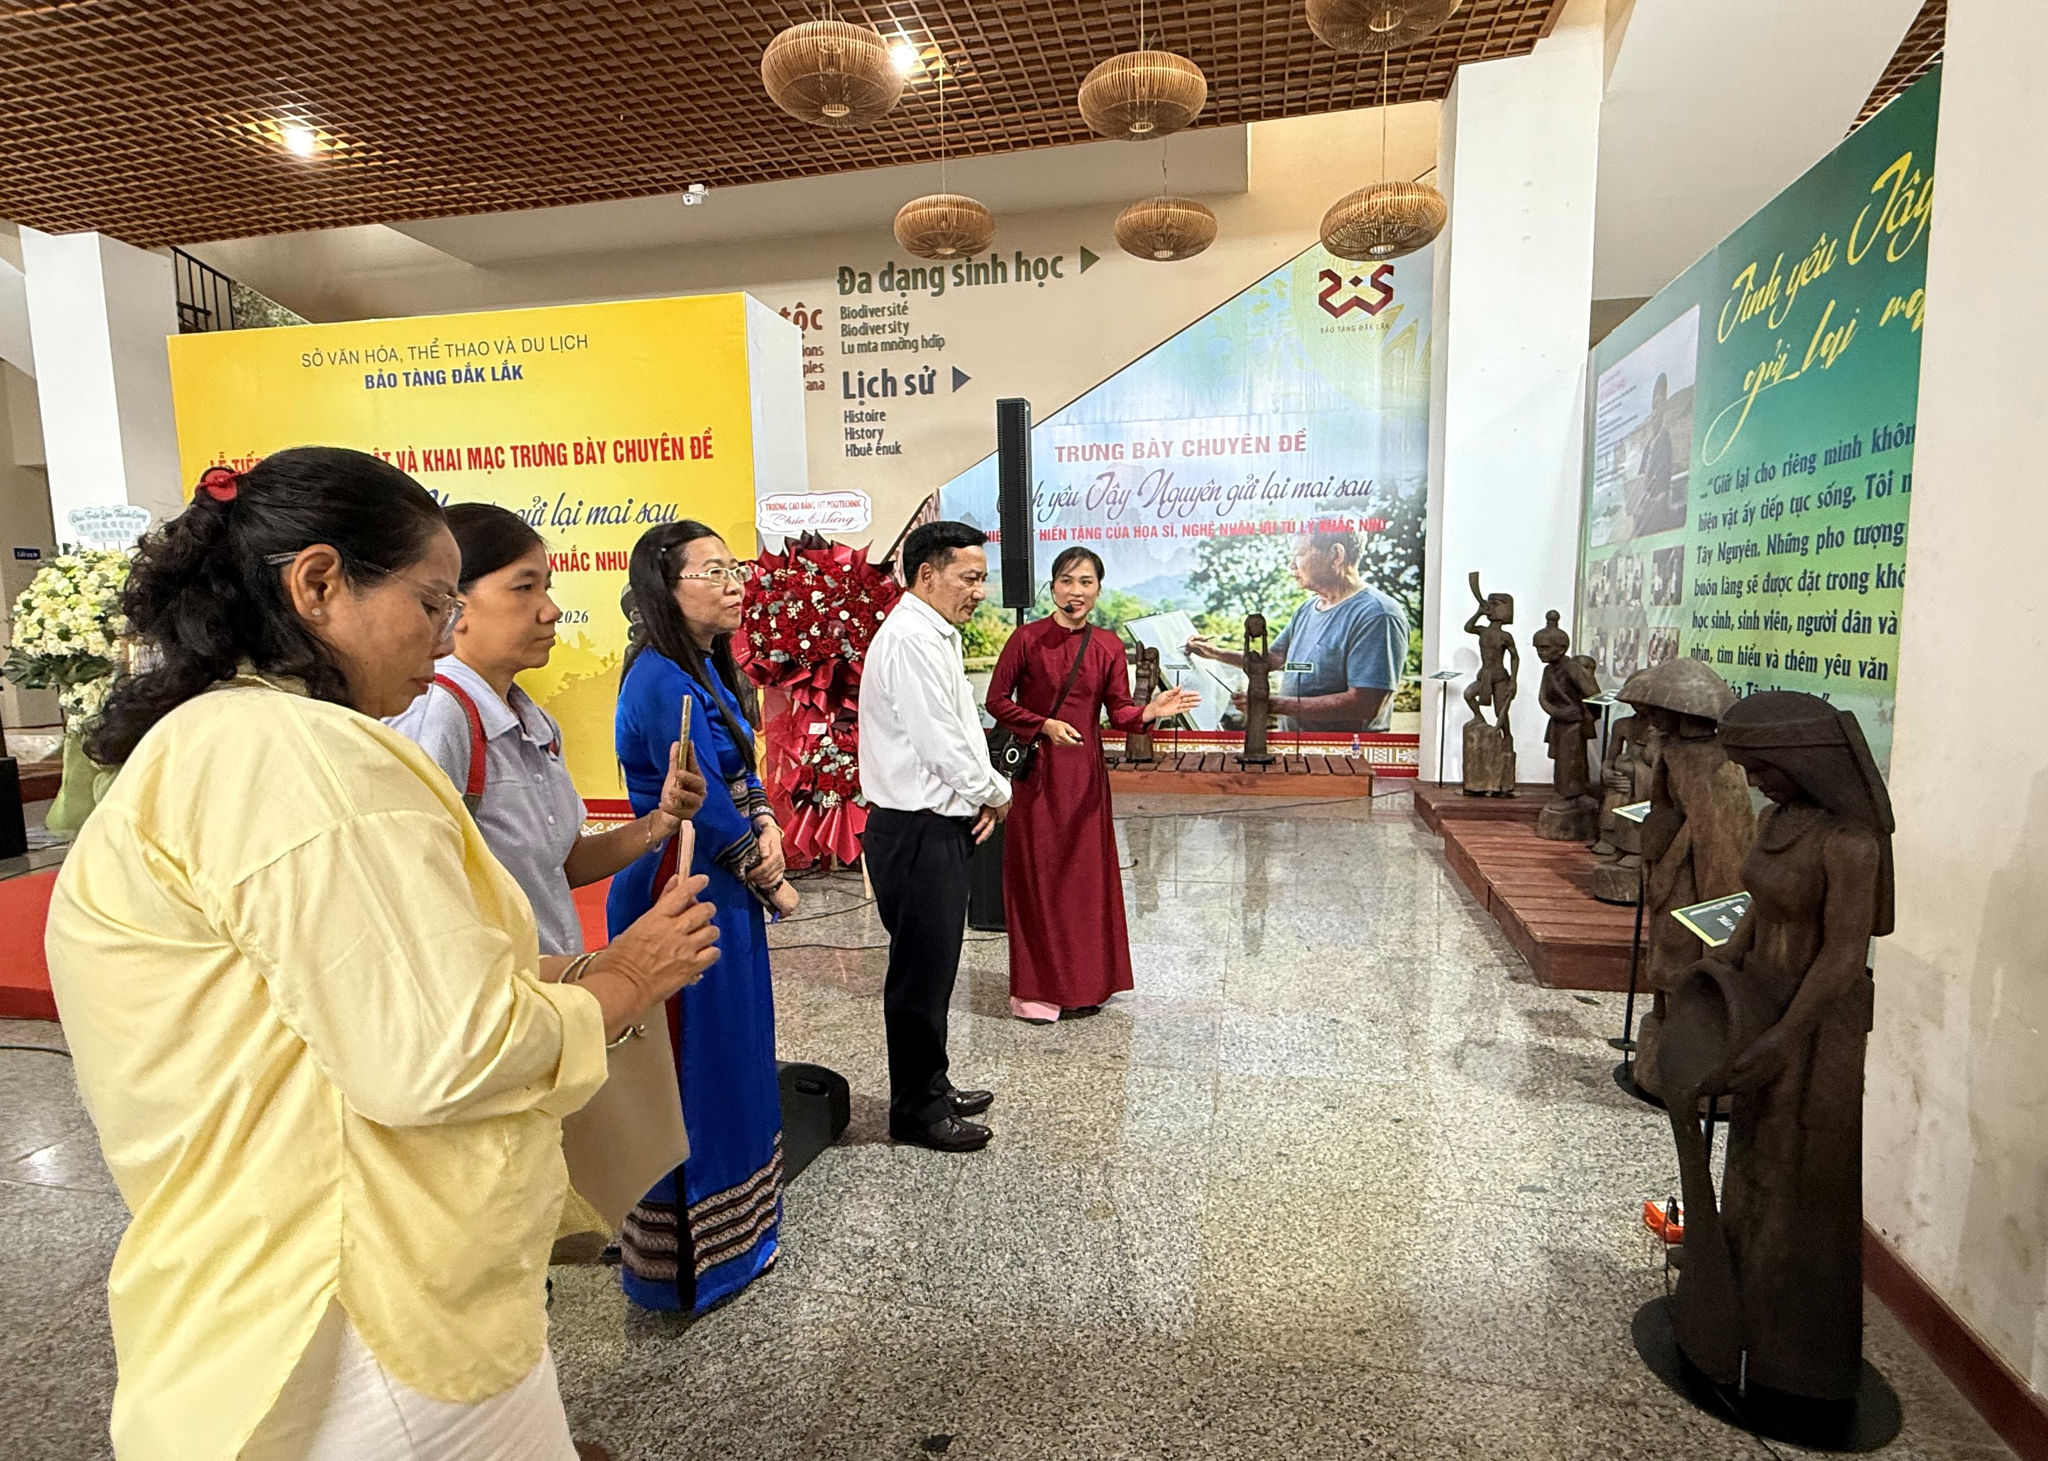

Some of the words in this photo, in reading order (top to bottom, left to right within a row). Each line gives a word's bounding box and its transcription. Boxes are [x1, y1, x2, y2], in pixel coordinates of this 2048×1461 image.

[1768, 232, 1838, 330] yêu
[1847, 151, 1934, 266] Tây
[837, 266, 872, 295] Đa
[878, 261, 944, 298] dạng
[952, 253, 1008, 287] sinh
[1015, 251, 1064, 288] học
[840, 301, 909, 320] Biodiversité
[841, 321, 909, 337] Biodiversity
[302, 348, 324, 368] SỞ
[328, 349, 360, 367] VĂN
[365, 344, 403, 364] HÓA,
[407, 338, 440, 360] THỂ
[445, 341, 490, 358] THAO
[494, 336, 519, 354] VÀ
[522, 337, 545, 353] DU
[550, 334, 588, 353] LỊCH
[1801, 299, 1861, 372] lại
[364, 368, 398, 390] BẢO
[402, 367, 447, 387] TÀNG
[451, 362, 486, 384] ĐẮK
[491, 359, 523, 382] LẮK
[842, 368, 898, 406] Lịch
[904, 365, 936, 395] sử
[844, 409, 886, 423] Histoire
[396, 445, 418, 473] VÀ
[422, 448, 462, 472] KHAI
[467, 446, 506, 475] MẠC
[510, 441, 568, 468] TRƯNG
[573, 436, 606, 465] BÀY
[613, 432, 684, 463] CHUYÊN
[690, 427, 714, 460] ĐỀ
[845, 427, 884, 444] History
[1054, 442, 1125, 463] TRƯNG
[1132, 437, 1174, 459] BÀY
[1181, 433, 1270, 458] CHUYÊN
[1278, 427, 1307, 452] ĐỀ
[1736, 466, 1750, 493] lại
[1754, 461, 1776, 484] cho
[1782, 452, 1817, 477] riêng
[1871, 422, 1916, 454] khôn
[551, 492, 582, 534] lại
[585, 498, 631, 526] mai
[633, 503, 679, 524] sau
[1038, 483, 1079, 523] yêu
[1085, 471, 1131, 520] Tây
[1137, 468, 1221, 519] Nguyên
[1215, 473, 1260, 517] gửi
[1260, 470, 1291, 506] lại
[1291, 475, 1335, 499] mai
[1335, 479, 1373, 498] sau
[1760, 494, 1784, 521] tiếp
[1790, 494, 1811, 518] tục
[1864, 469, 1894, 500] Tôi
[1039, 524, 1067, 541] HIẾN
[1070, 524, 1102, 543] TẶNG
[1105, 522, 1130, 540] CỦA
[1182, 519, 1215, 538] NGHỆ
[1280, 517, 1296, 534] TÚ
[1300, 517, 1314, 533] LÝ
[1697, 545, 1713, 567] Tây
[1766, 532, 1809, 556] Những
[1815, 525, 1845, 555] pho
[1853, 522, 1906, 550] tượng
[548, 545, 590, 572] KHẮC
[595, 551, 628, 571] NHU
[1721, 576, 1744, 599] làng
[1746, 574, 1758, 594] sẽ
[1762, 571, 1793, 597] được
[1797, 569, 1821, 597] đặt
[1826, 571, 1870, 595] trong
[1875, 562, 1907, 589] khô
[1692, 610, 1709, 632] học
[1711, 609, 1735, 631] sinh,
[1737, 609, 1760, 630] sinh
[1763, 609, 1793, 634] viên,
[1796, 608, 1838, 637] người
[1841, 608, 1872, 634] dân
[1878, 610, 1898, 635] và
[1717, 644, 1734, 664] tìm
[1737, 643, 1761, 667] hiểu
[1766, 648, 1779, 669] và
[1785, 649, 1818, 673] thêm
[1824, 653, 1852, 680] yêu
[1858, 656, 1888, 681] văn
